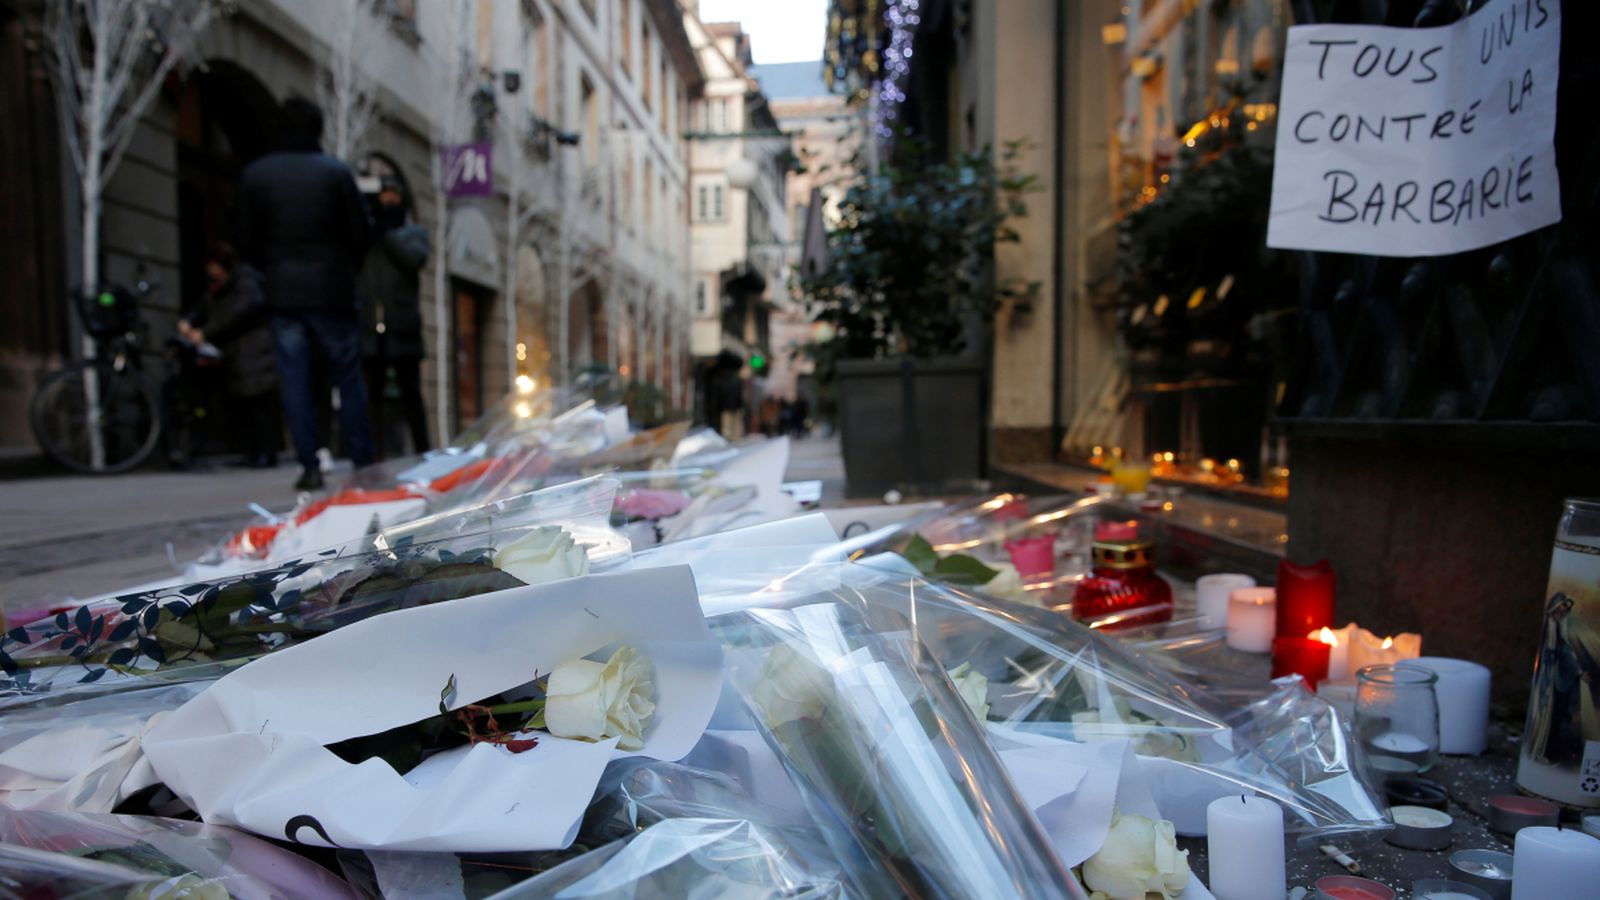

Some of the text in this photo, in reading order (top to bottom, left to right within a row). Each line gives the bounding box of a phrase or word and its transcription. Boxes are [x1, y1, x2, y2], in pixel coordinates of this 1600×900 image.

[1308, 0, 1549, 83] TOUS UNIS
[1508, 68, 1534, 115] LA
[1317, 155, 1534, 226] BARBARIE
